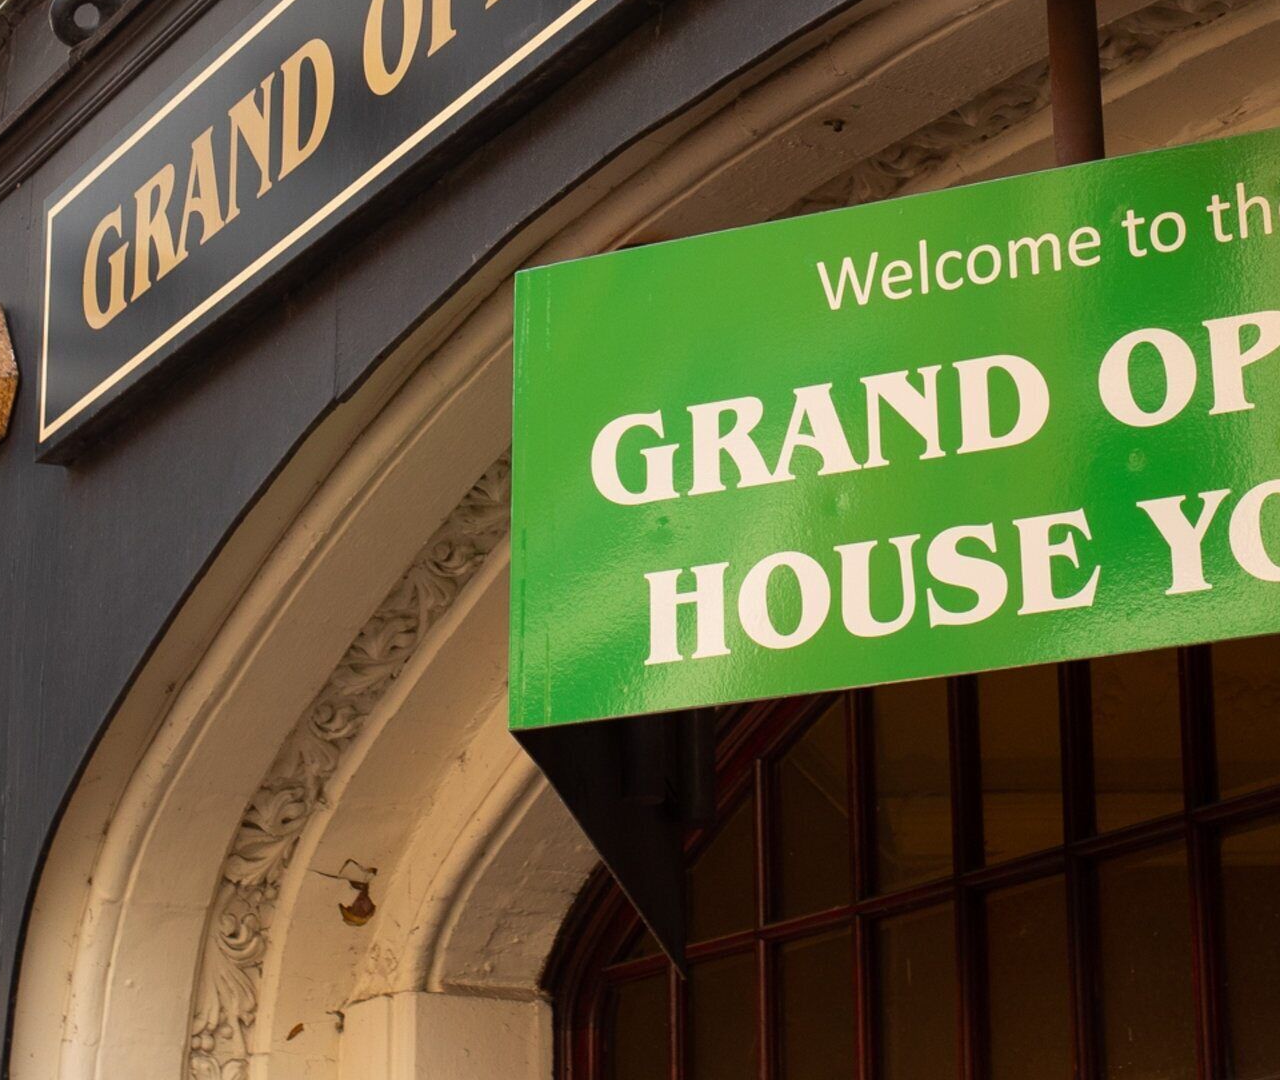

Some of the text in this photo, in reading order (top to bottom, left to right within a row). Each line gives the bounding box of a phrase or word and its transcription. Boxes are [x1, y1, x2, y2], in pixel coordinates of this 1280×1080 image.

[83, 38, 334, 330] GRAND
[816, 226, 1101, 311] Welcome
[1121, 210, 1186, 257] to
[591, 355, 1049, 505] GRAND
[644, 508, 1100, 665] HOUSE
